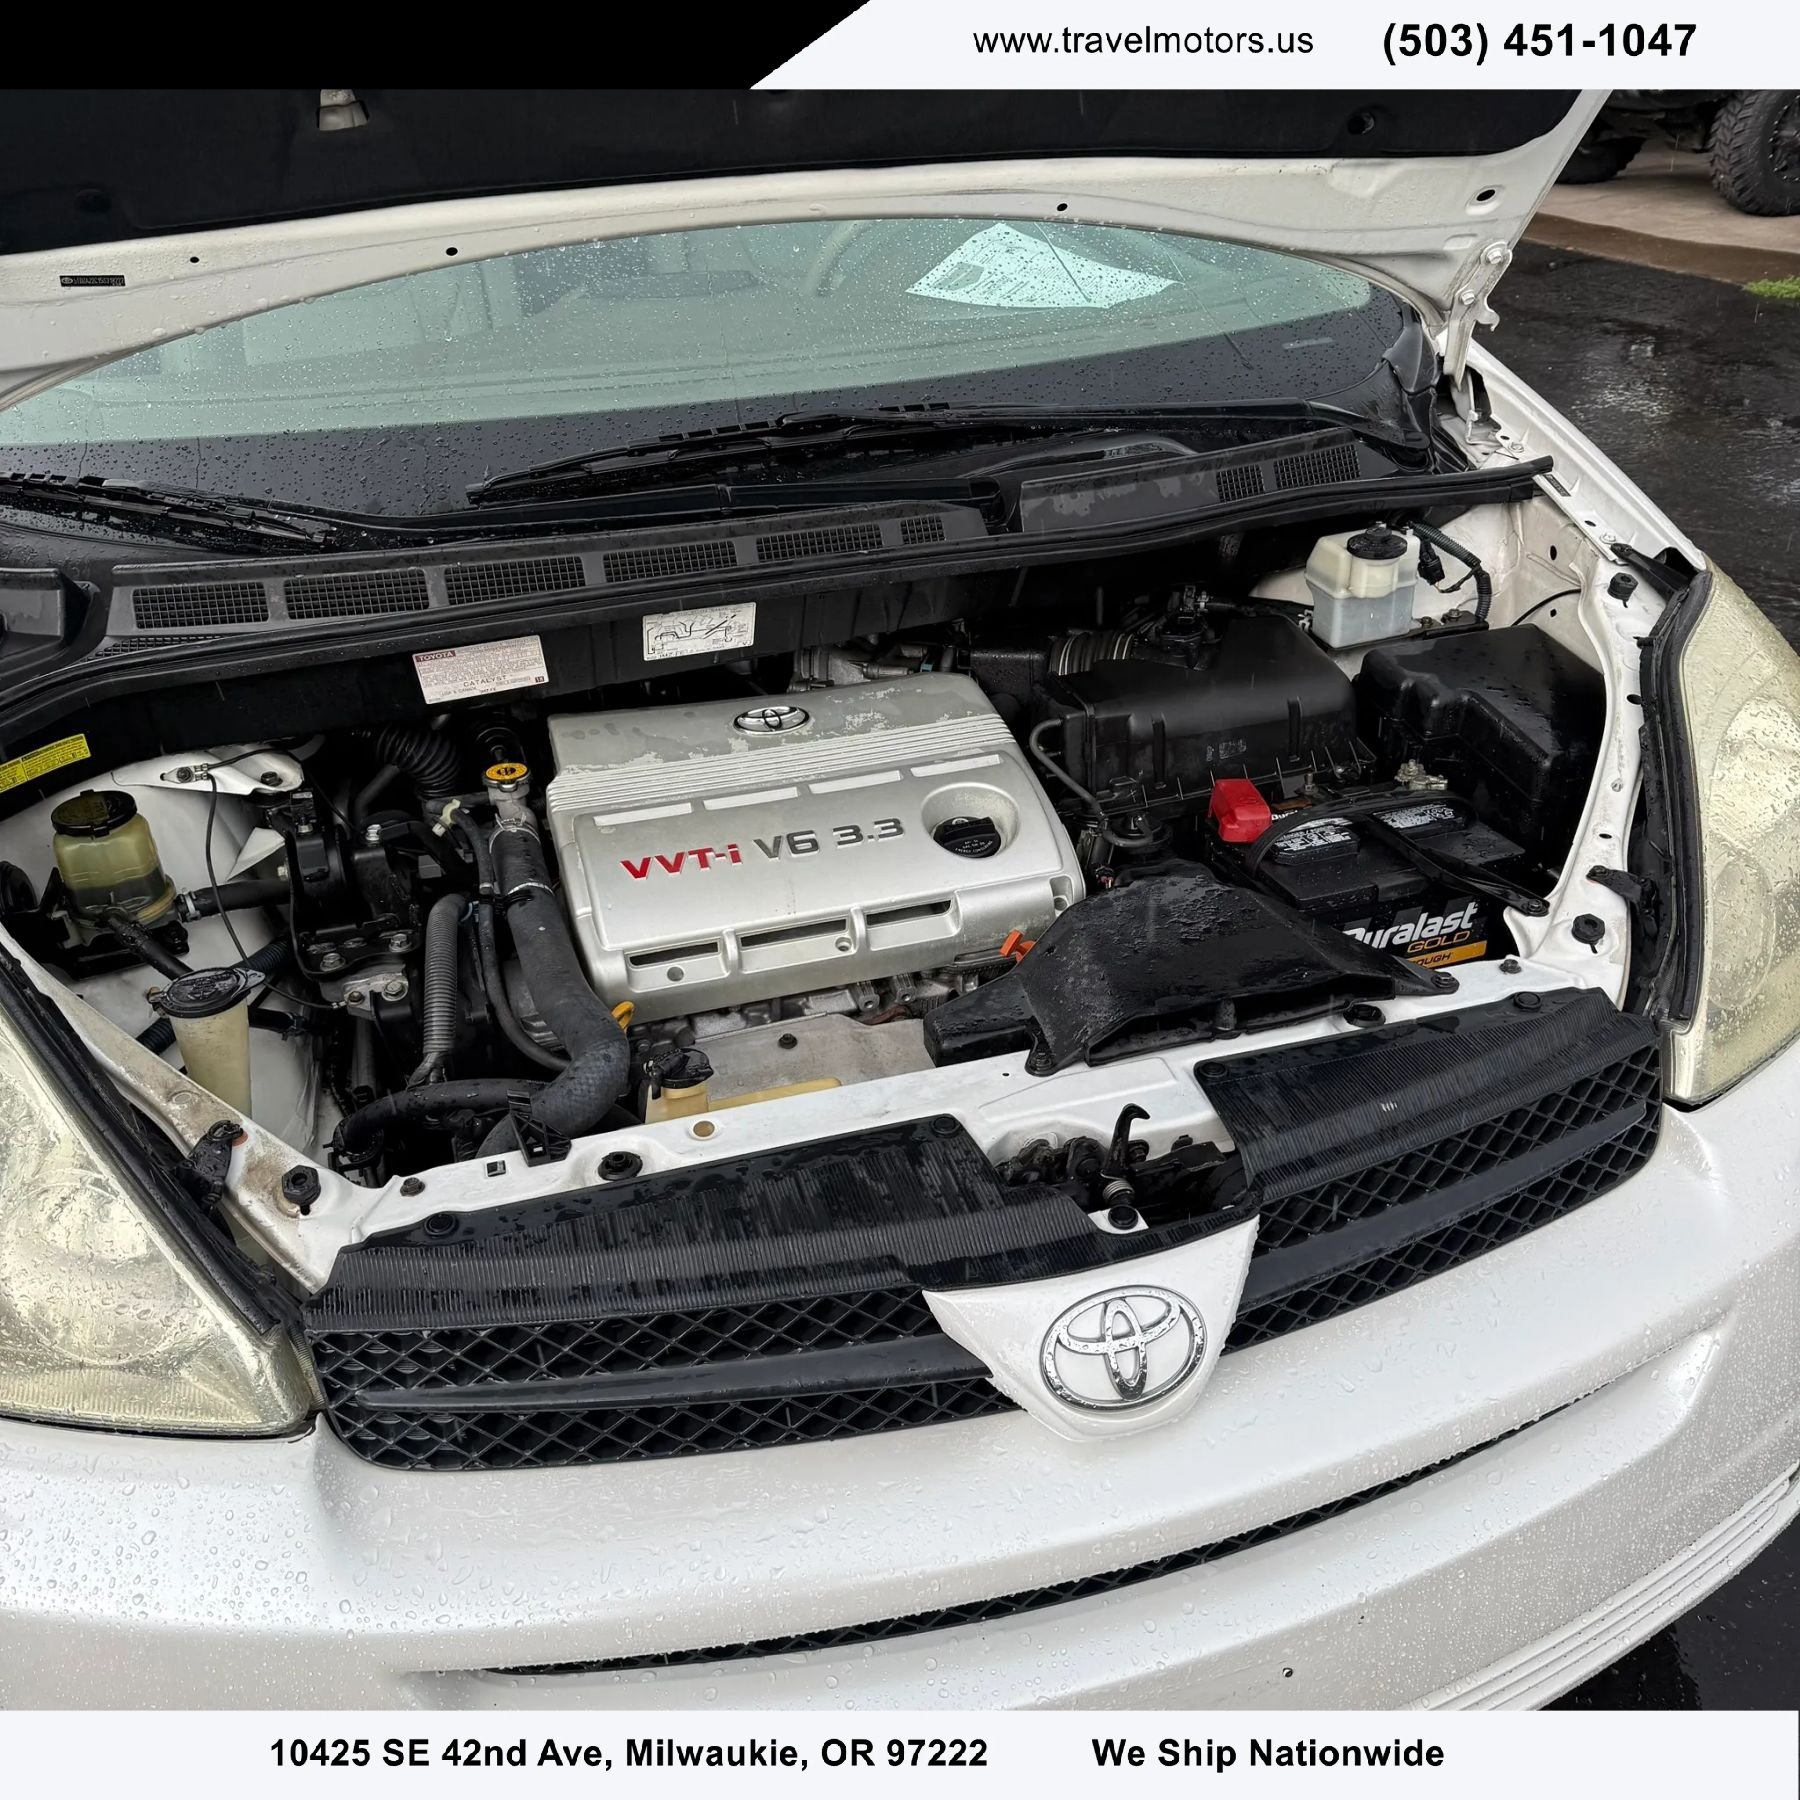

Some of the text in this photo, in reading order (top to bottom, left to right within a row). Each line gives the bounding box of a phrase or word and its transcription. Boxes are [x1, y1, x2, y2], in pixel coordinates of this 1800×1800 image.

[420, 651, 454, 662] TOYOTA
[463, 675, 507, 687] CATALYST
[620, 817, 905, 880] VVT-i V6 3.3
[1407, 930, 1471, 953] GOLD
